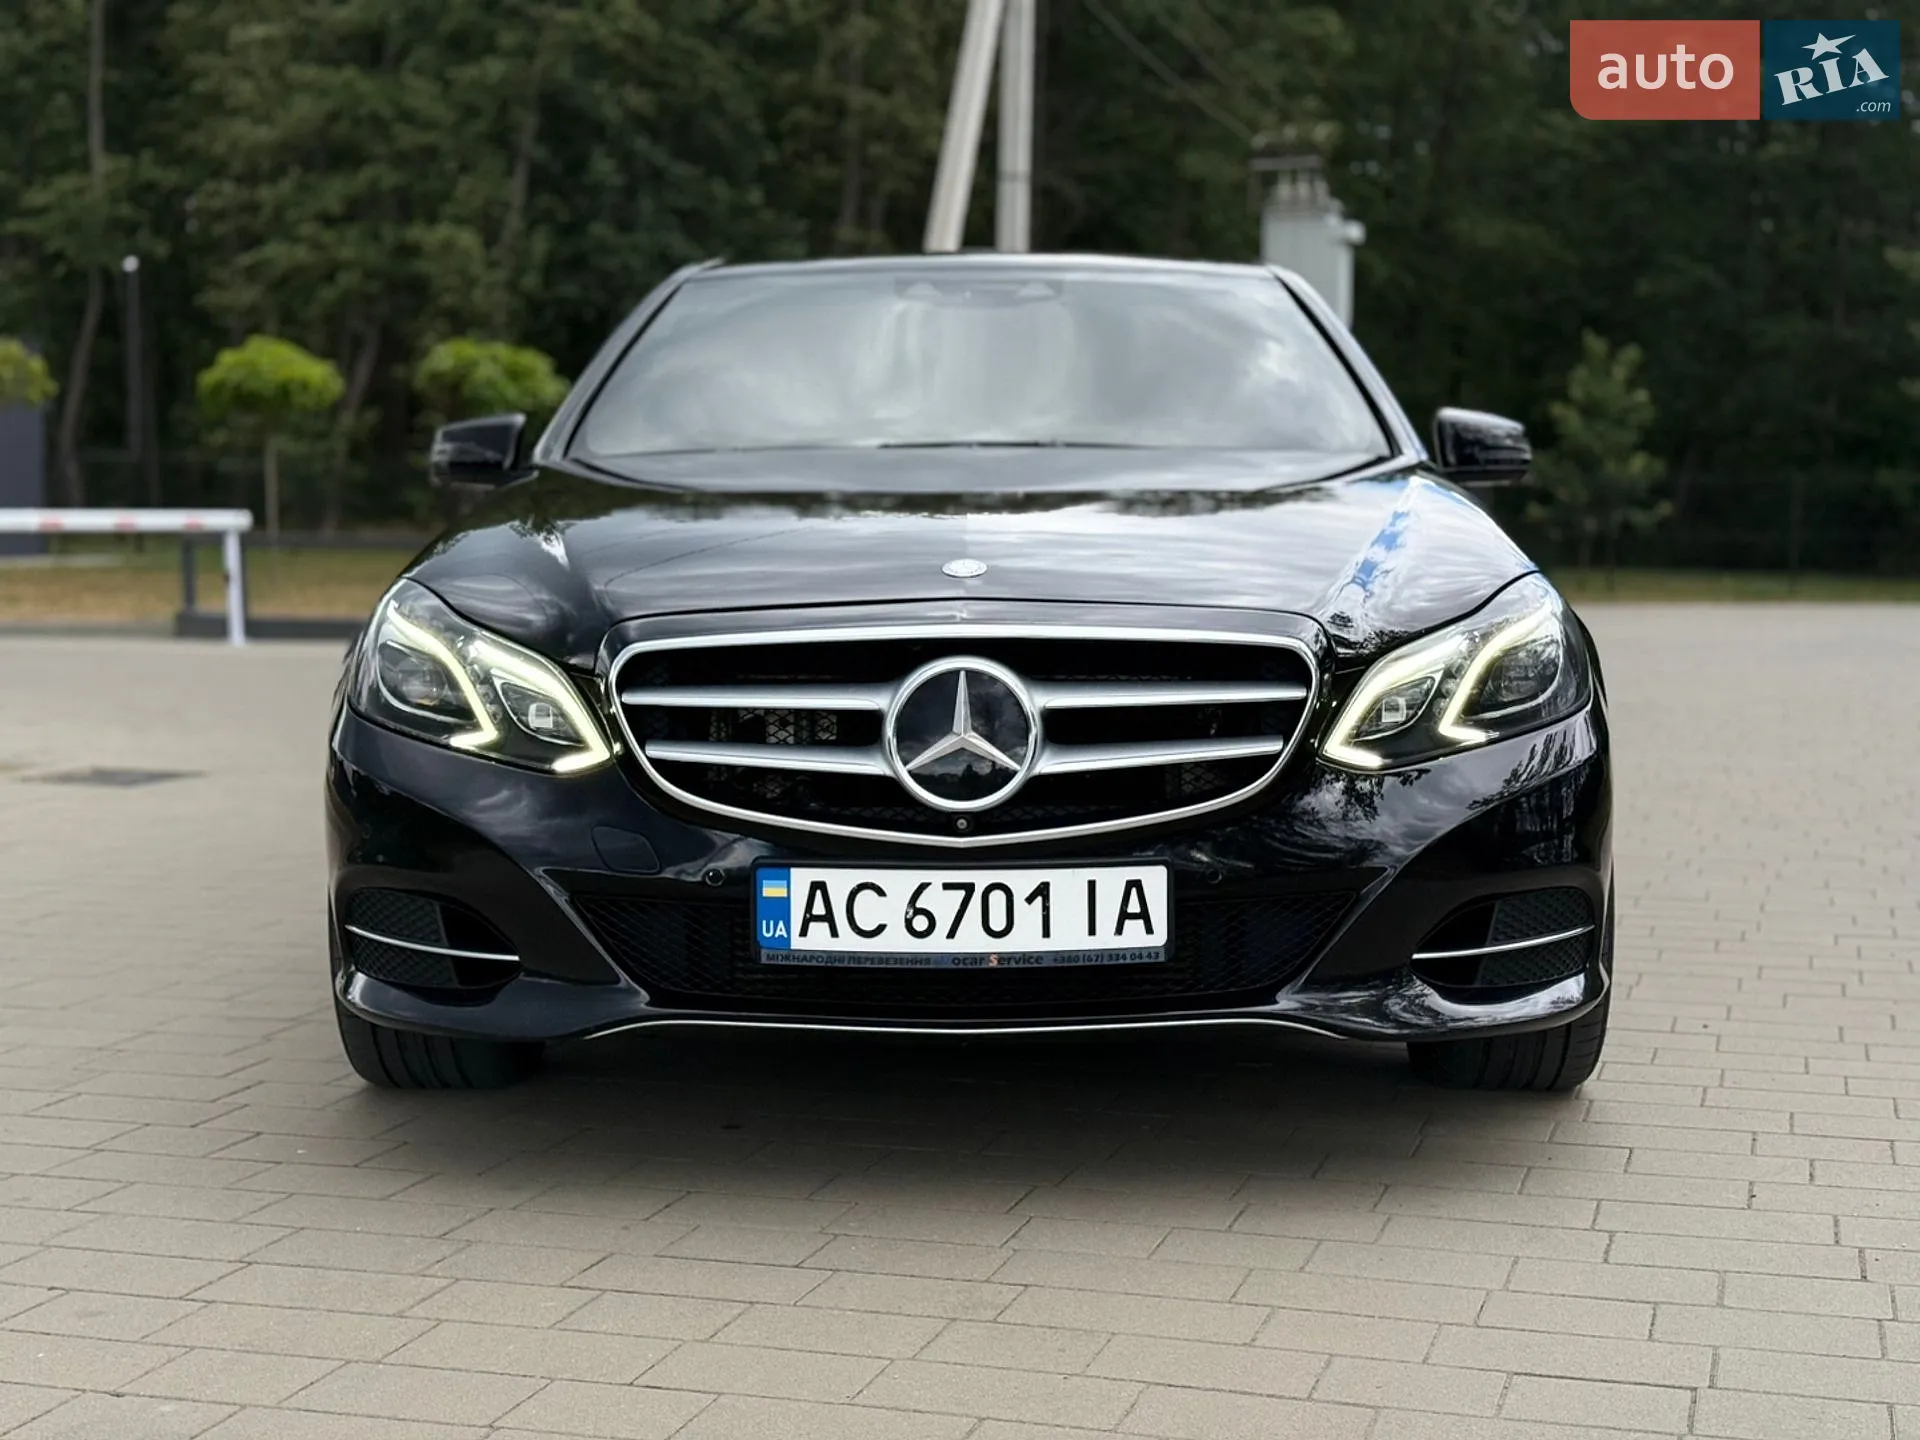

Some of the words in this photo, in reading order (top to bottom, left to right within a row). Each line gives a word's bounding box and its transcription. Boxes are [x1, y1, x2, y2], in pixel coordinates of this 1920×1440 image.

[762, 919, 788, 938] UA
[798, 880, 887, 939] AC
[904, 881, 1051, 939] 6701
[1087, 879, 1155, 937] IA
